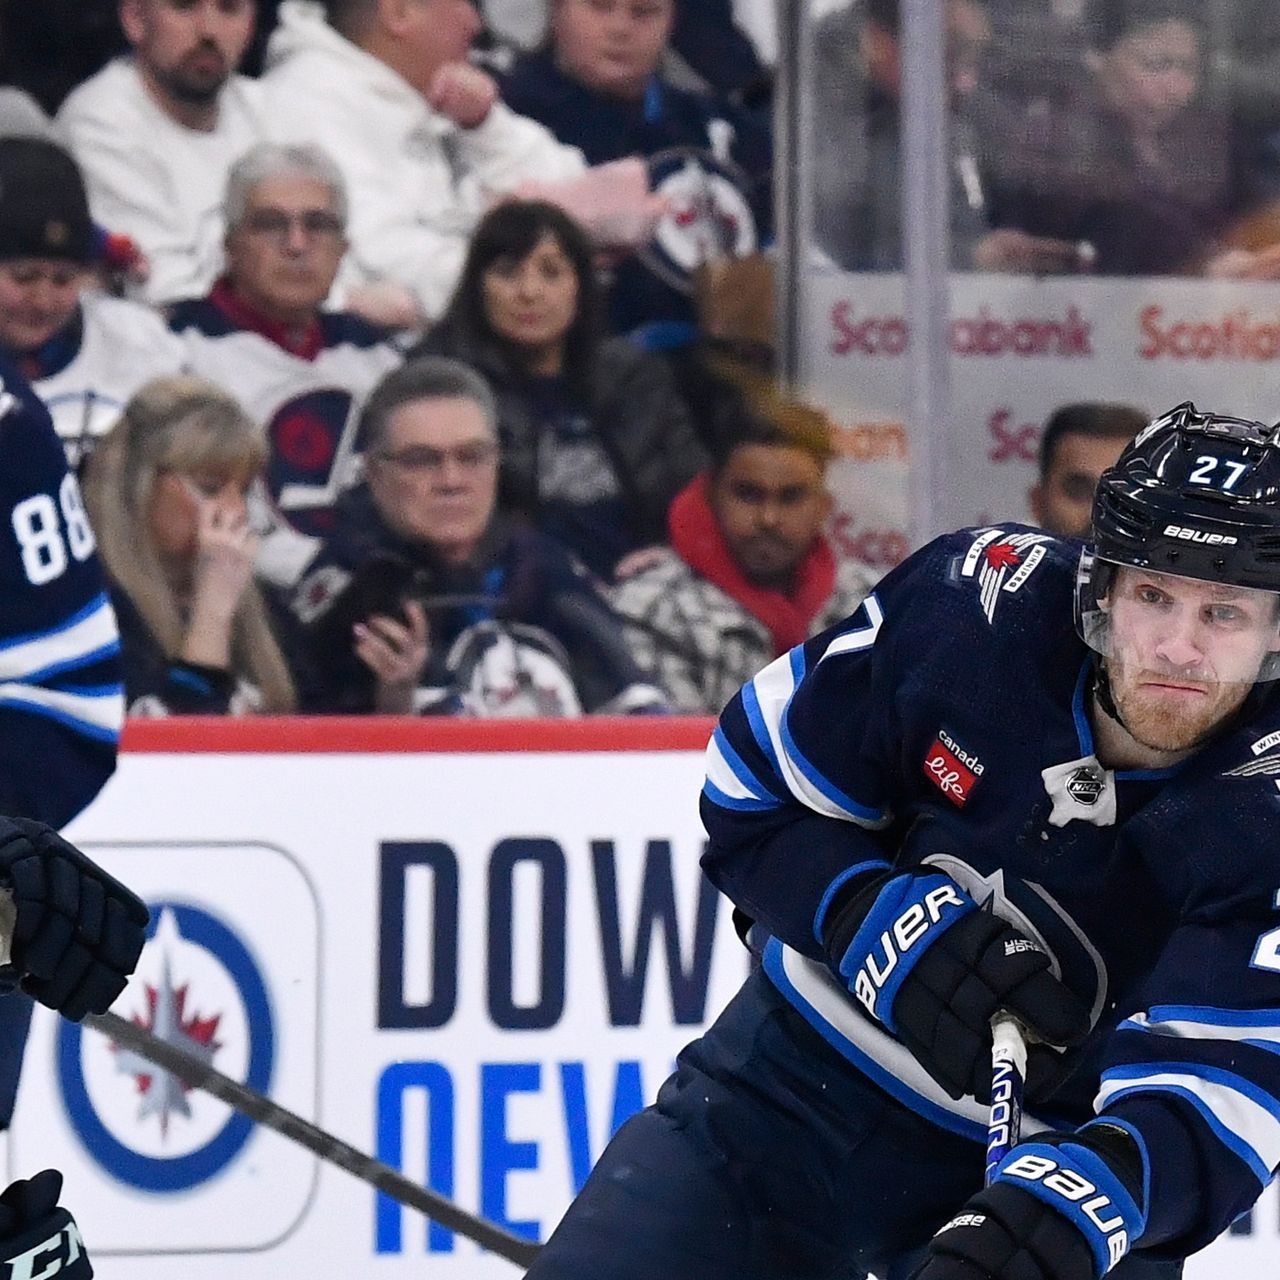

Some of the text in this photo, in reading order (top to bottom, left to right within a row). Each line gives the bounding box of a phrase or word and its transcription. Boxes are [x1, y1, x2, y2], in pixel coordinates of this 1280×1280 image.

[11, 472, 97, 577] 88
[1188, 456, 1248, 490] 27
[925, 757, 967, 802] life
[938, 729, 985, 778] canada
[375, 837, 722, 1031] DOW
[854, 885, 965, 1021] AUER
[1002, 1154, 1128, 1273] BAUE
